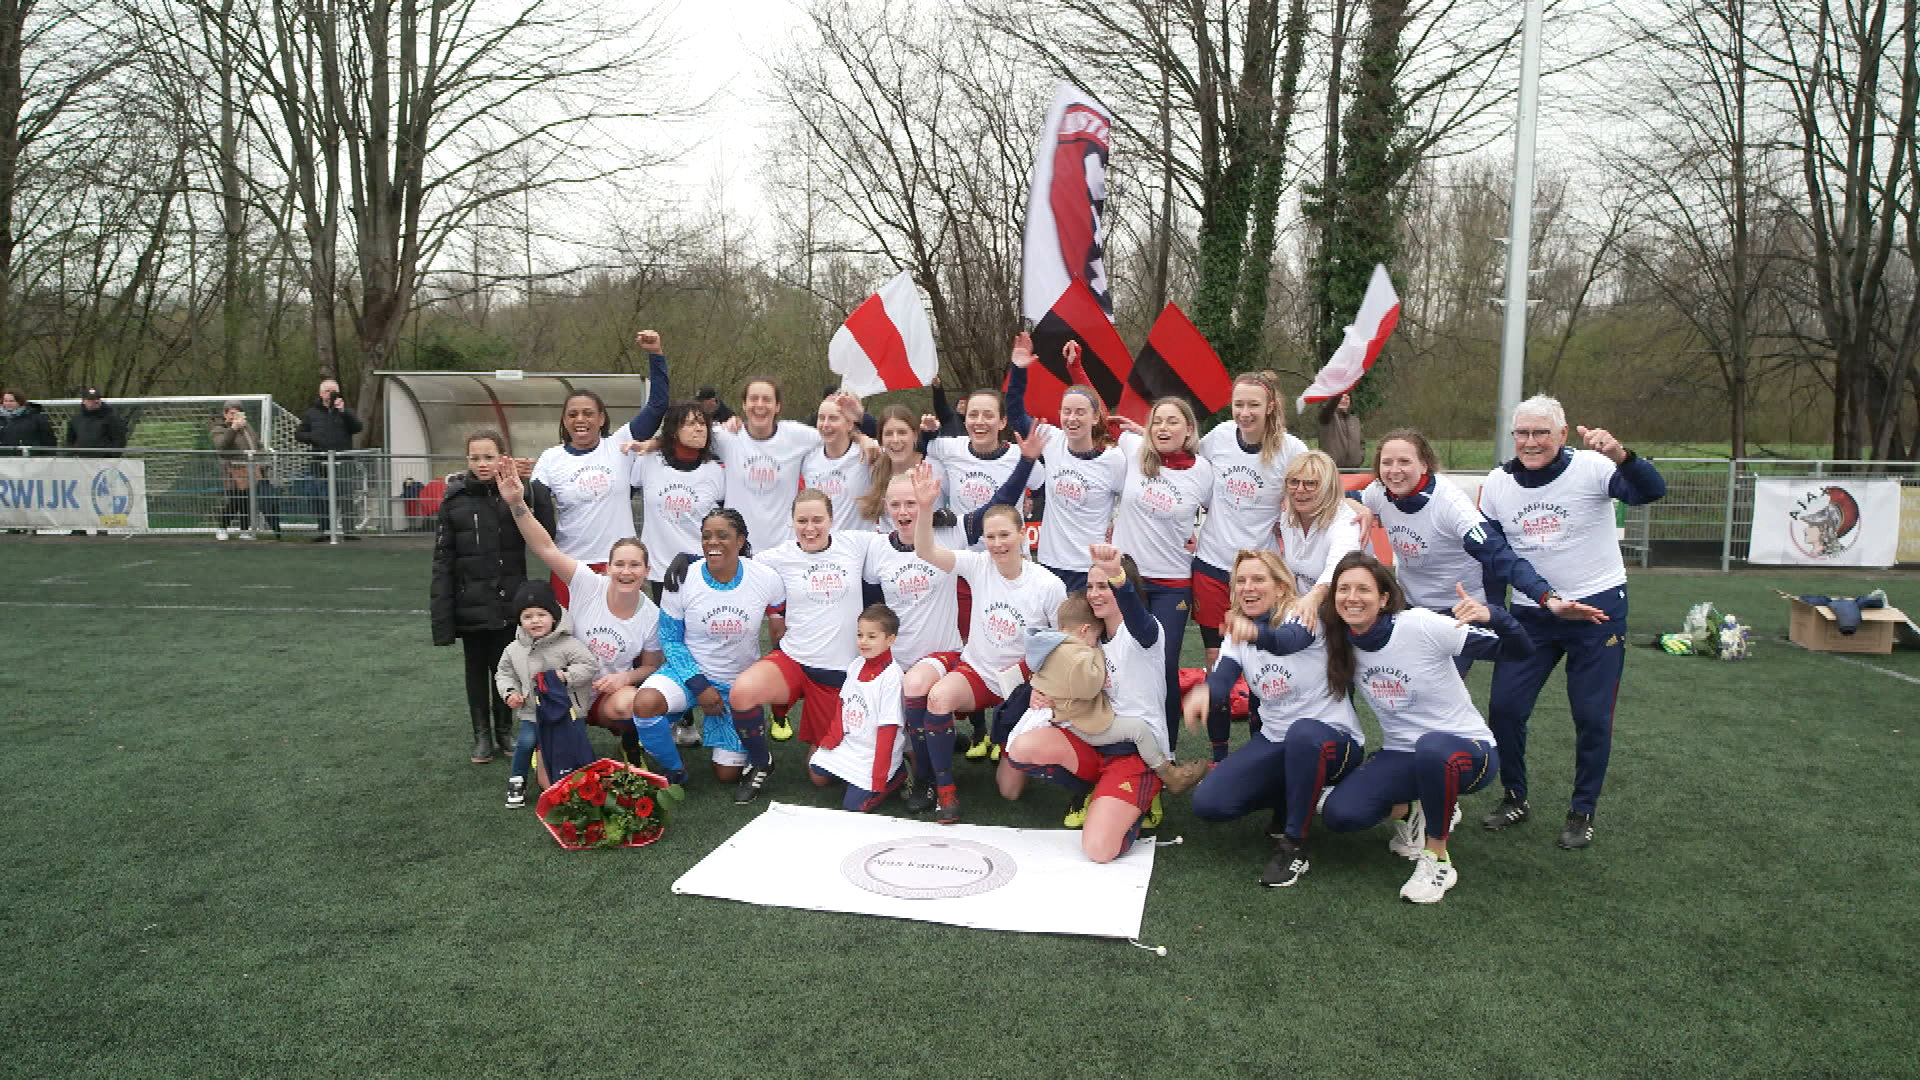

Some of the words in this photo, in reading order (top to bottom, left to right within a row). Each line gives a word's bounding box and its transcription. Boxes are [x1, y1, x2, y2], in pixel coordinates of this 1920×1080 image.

[1053, 469, 1090, 492] KAMPIOEN
[1222, 466, 1264, 488] KAMPIOEN
[1227, 478, 1256, 490] AJAX
[0, 479, 81, 509] RWIJK
[964, 483, 991, 494] AJAX
[1056, 480, 1081, 493] AJAX
[1141, 477, 1183, 504] KAMPIOEN
[1145, 487, 1174, 504] AJAX
[665, 495, 692, 505] AJAX
[1789, 486, 1829, 521] AJAX
[1511, 502, 1570, 525] KAMPIOEN
[1523, 515, 1559, 527] AJAX
[1392, 535, 1418, 551] AJAX
[801, 563, 849, 581] KAMPIOEN
[811, 573, 842, 583] AJAX
[890, 563, 936, 584] KAMPIOEN
[898, 575, 929, 586] AJAX
[701, 605, 750, 625] KAMPIOEN
[711, 618, 742, 627] AJAX
[985, 601, 1027, 627] KAMPIOEN
[989, 613, 1017, 631] AJAX
[586, 626, 627, 653] KAMPIOEN
[591, 637, 618, 654] AJAX
[1252, 663, 1292, 686] KAMPOEN
[1372, 679, 1403, 689] AJAX
